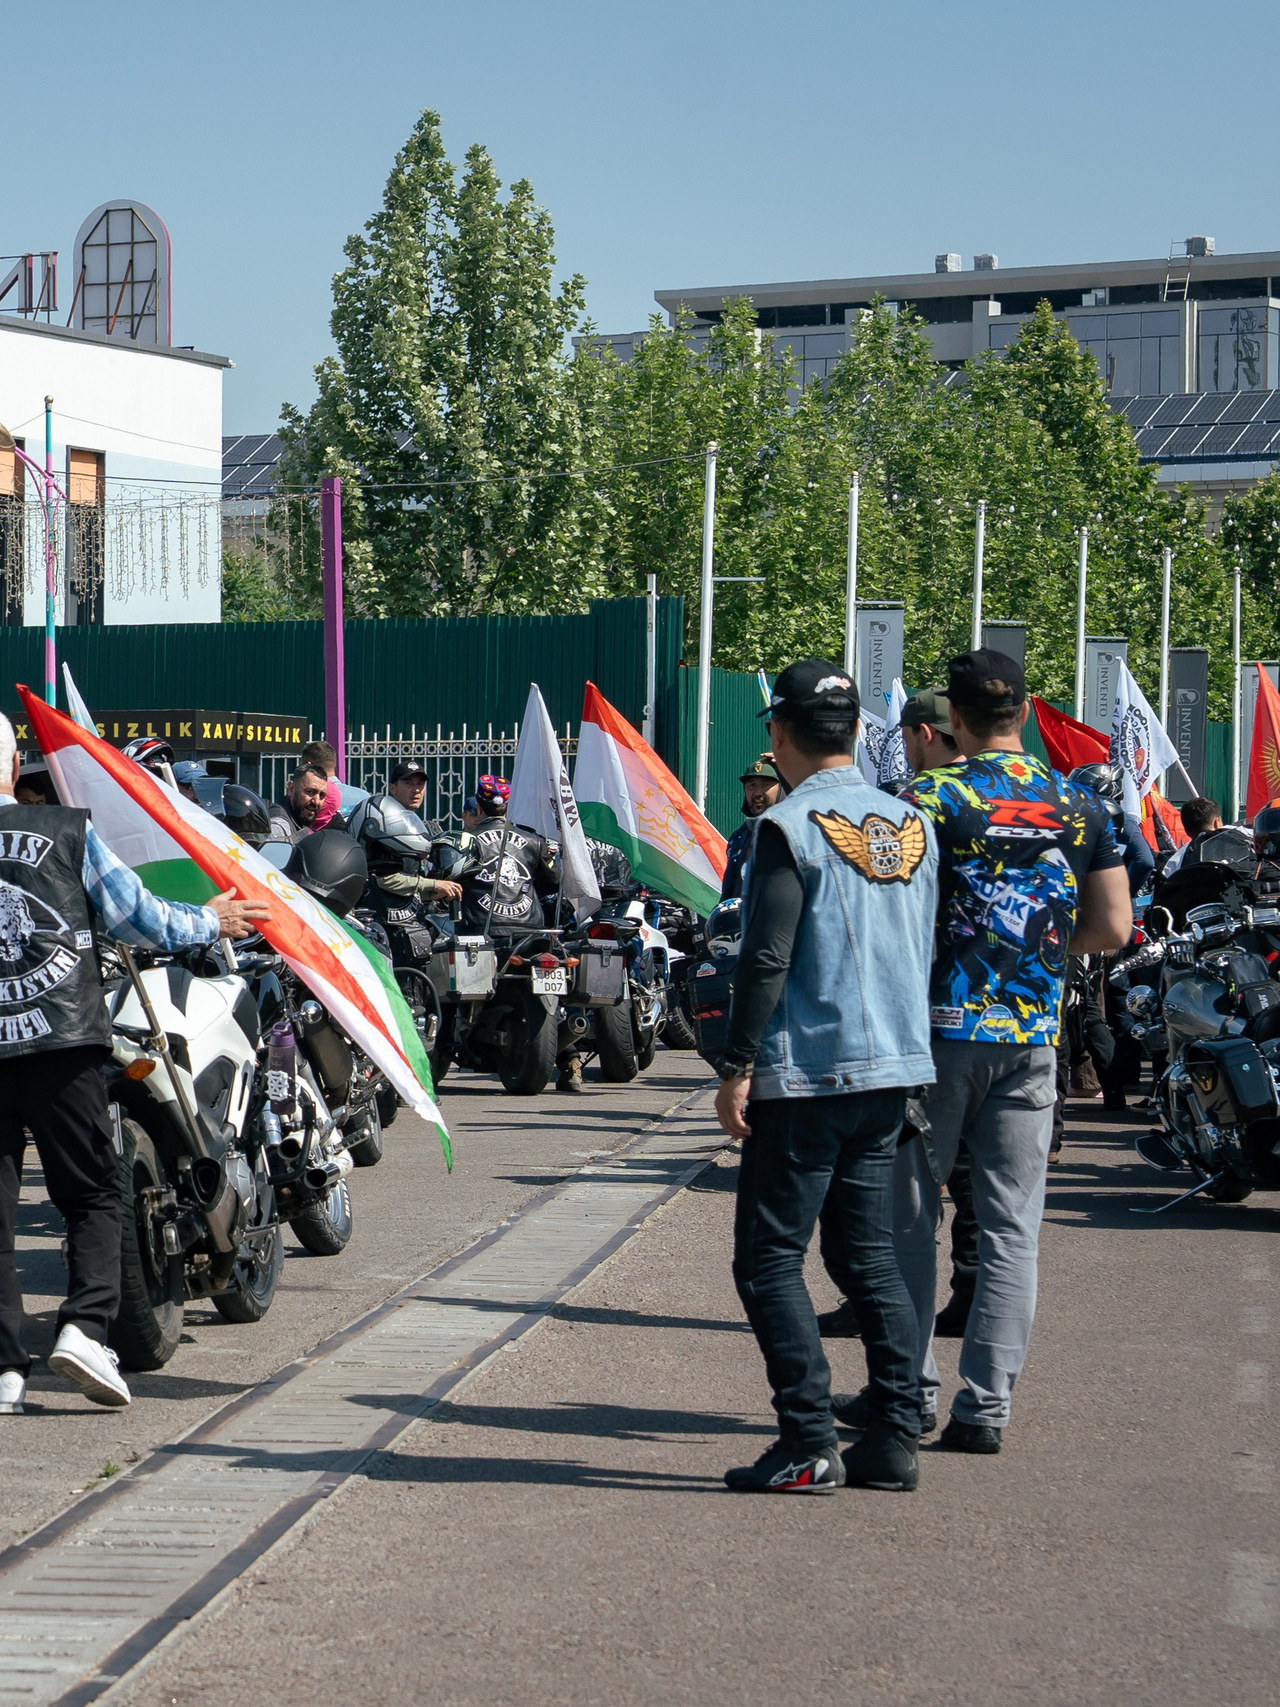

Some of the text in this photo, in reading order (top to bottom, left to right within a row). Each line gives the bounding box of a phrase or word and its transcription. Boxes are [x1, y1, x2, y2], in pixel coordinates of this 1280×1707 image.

[872, 638, 883, 698] INVENTO
[1099, 667, 1109, 717] INVENTO
[202, 722, 301, 744] XAVFSIZLIK
[984, 826, 1066, 840] GSX
[544, 982, 563, 992] D07
